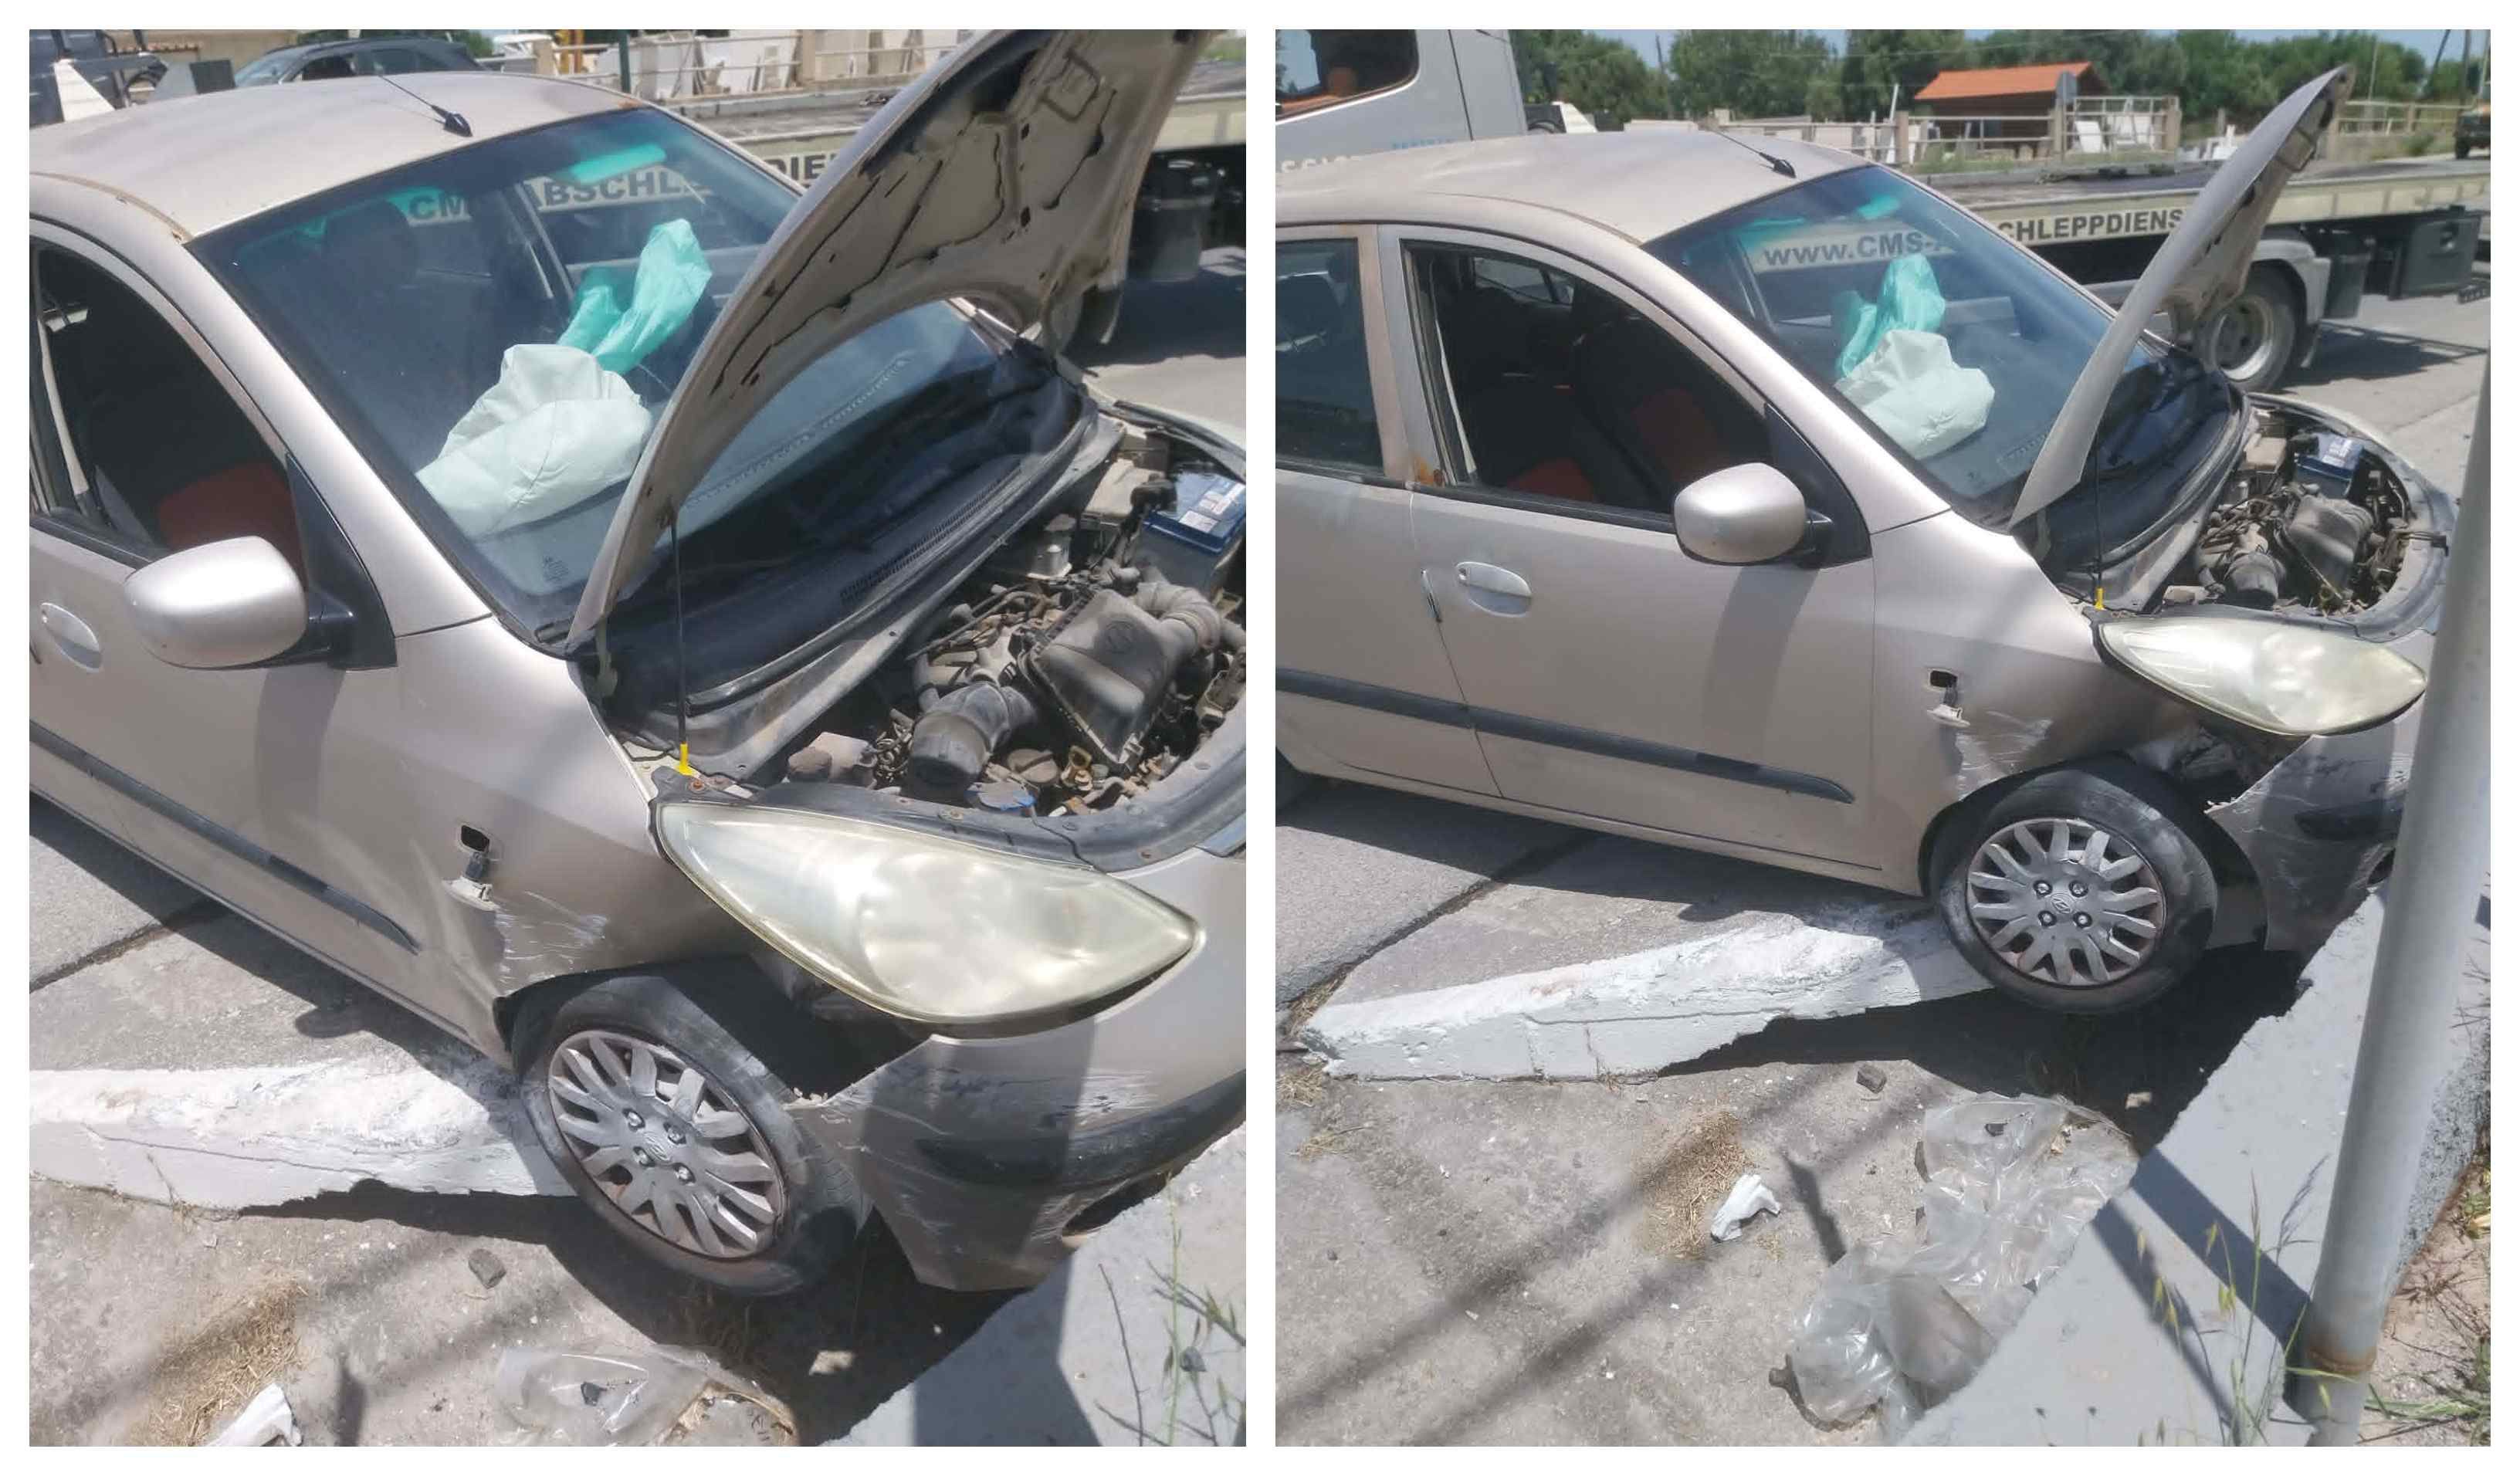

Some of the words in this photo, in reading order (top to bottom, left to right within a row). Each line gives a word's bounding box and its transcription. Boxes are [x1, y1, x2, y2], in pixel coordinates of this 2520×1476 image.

[528, 171, 698, 208] BSCHL
[764, 154, 834, 181] DIE
[1764, 232, 1936, 266] www.CMS-
